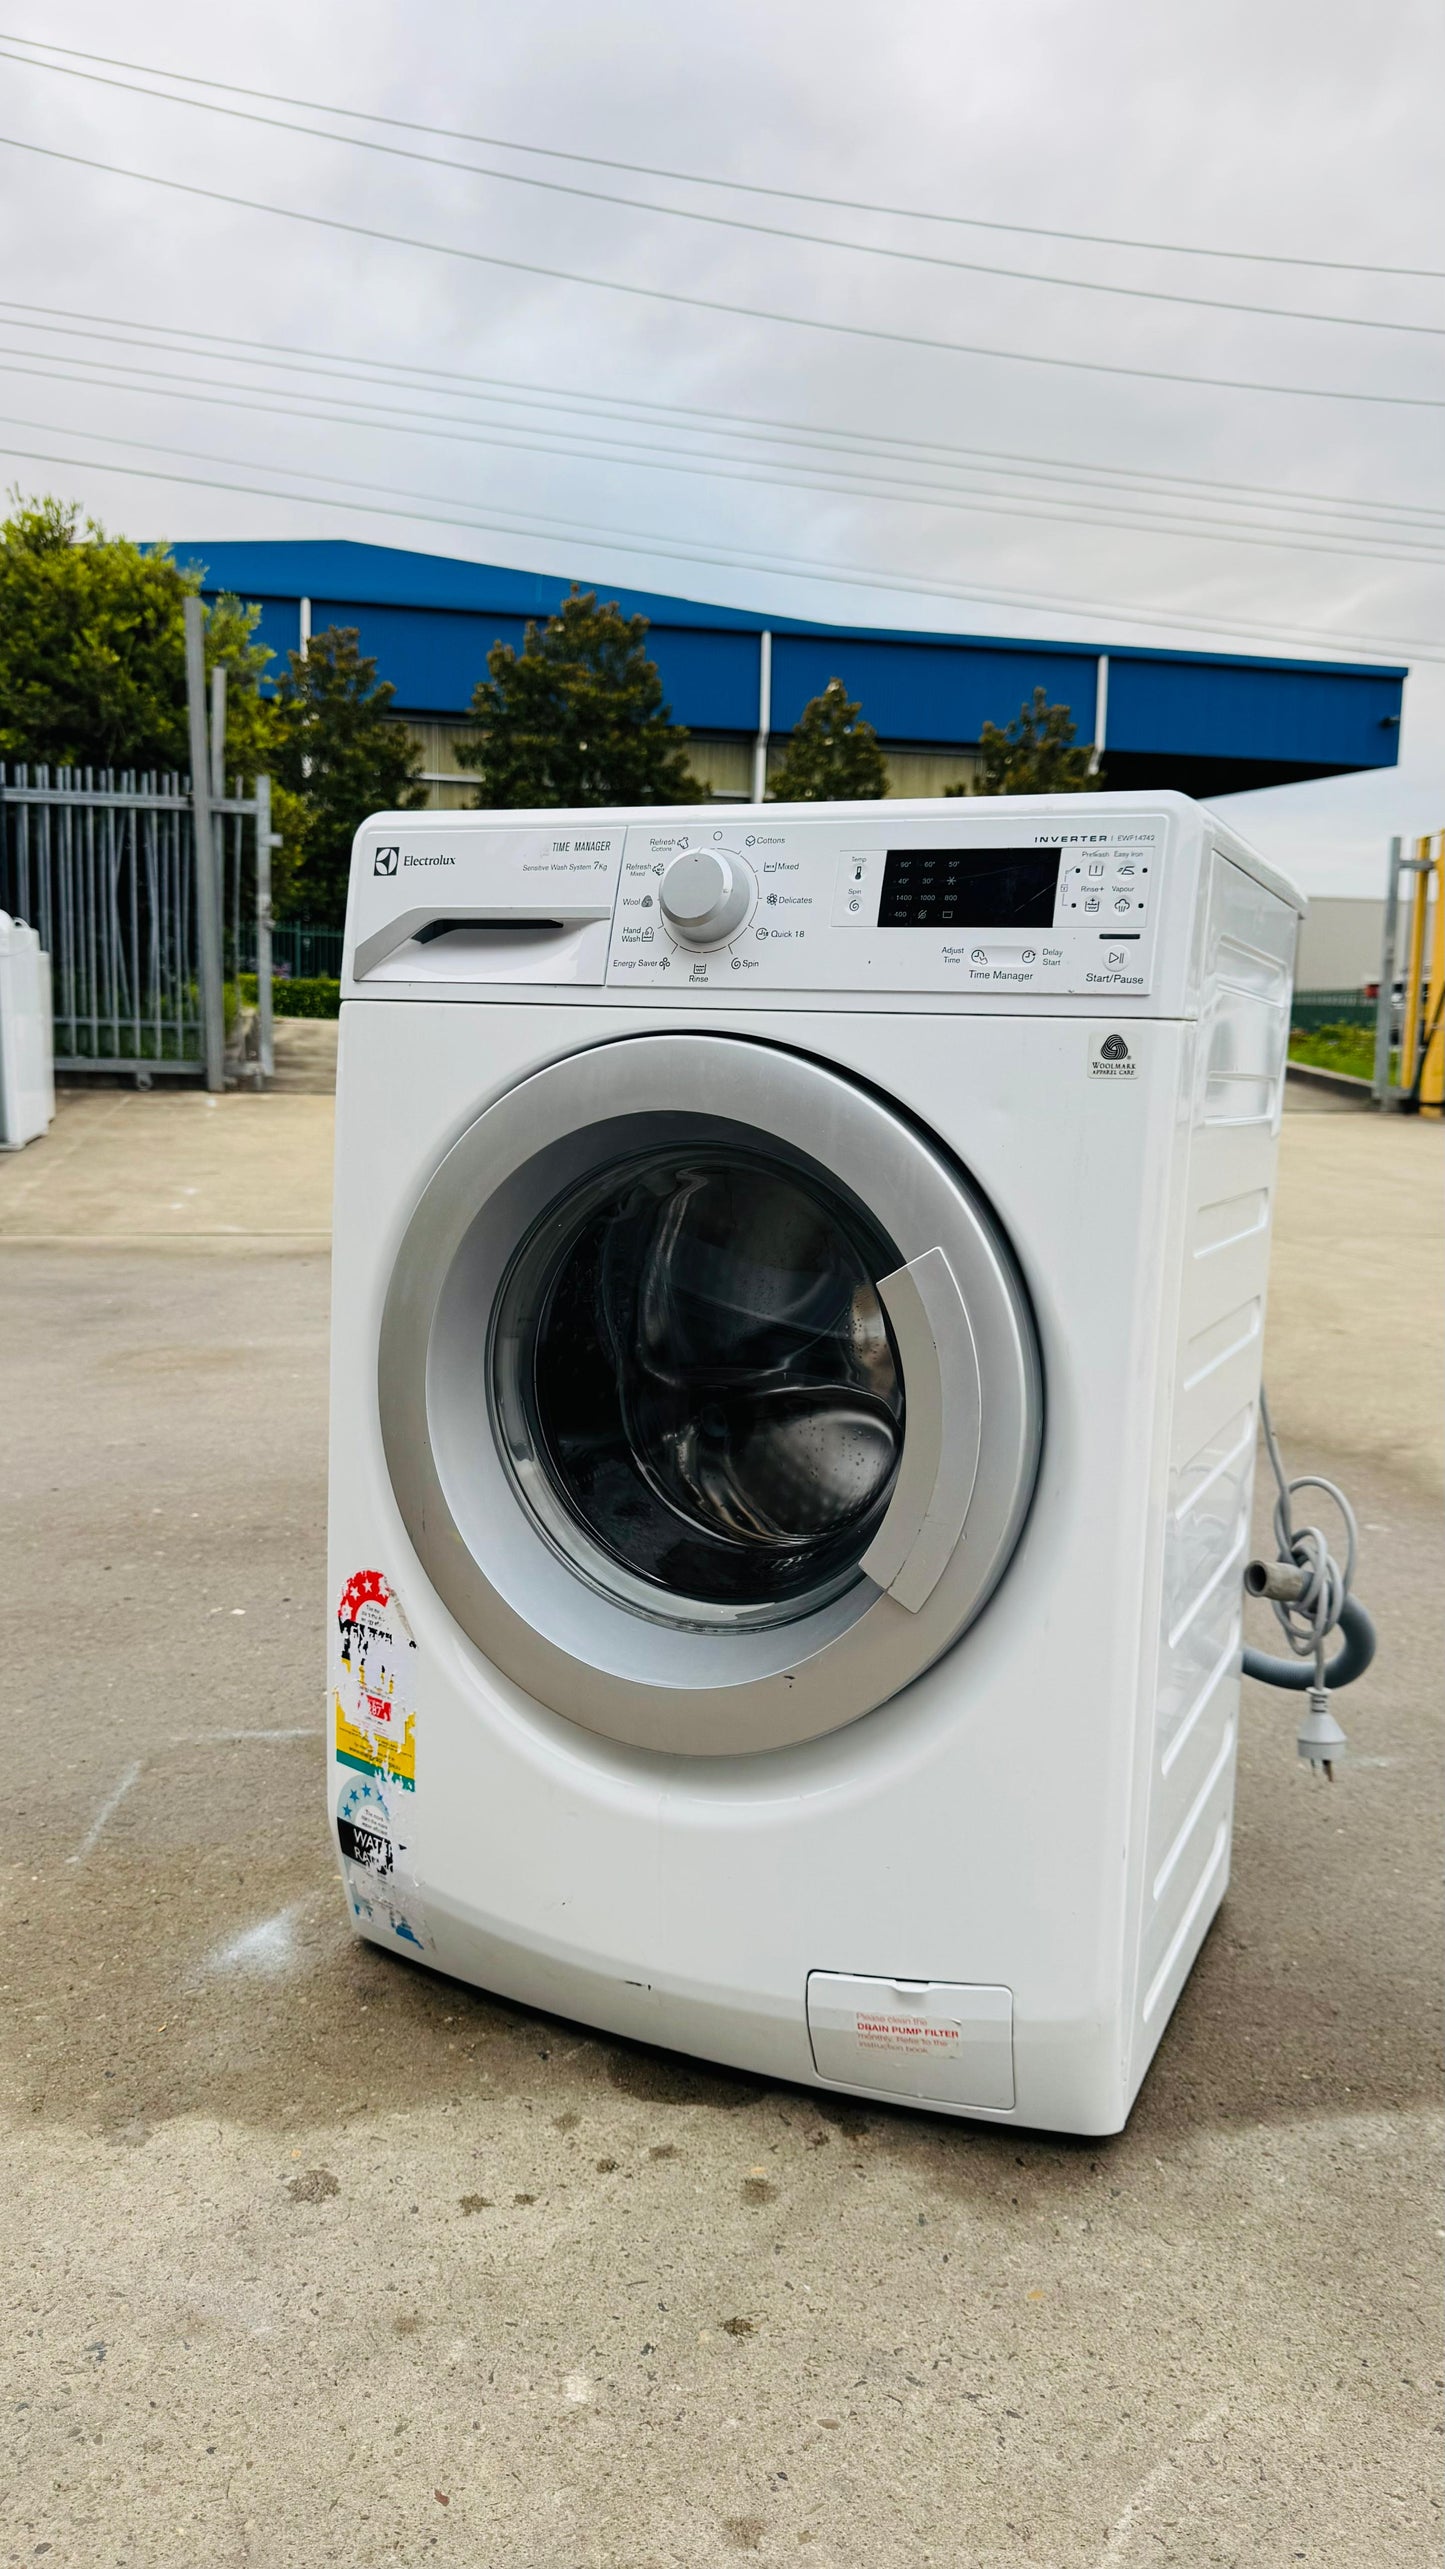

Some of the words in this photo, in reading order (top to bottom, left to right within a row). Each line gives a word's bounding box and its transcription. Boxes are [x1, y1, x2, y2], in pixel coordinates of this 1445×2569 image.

[650, 838, 676, 846] Refresh
[1034, 835, 1107, 843] INVERTER
[552, 842, 571, 853] TIME
[574, 841, 611, 852] MANAGER
[1113, 851, 1129, 859] Easy
[404, 854, 456, 867] Electrolux
[522, 863, 549, 872] Sensitive
[550, 863, 568, 871] Wash
[568, 863, 592, 872] System
[626, 863, 651, 871] Refresh
[848, 888, 862, 896] Spin
[622, 898, 641, 906] Wool
[778, 896, 813, 904] Delicates
[771, 930, 792, 938] Quick
[794, 930, 805, 938] 18
[621, 935, 641, 943] Wash
[941, 946, 964, 955] Adjust
[1042, 948, 1064, 958] Delay
[613, 960, 637, 968] Energy
[742, 959, 759, 968] Spin
[943, 956, 961, 964] Time
[1042, 958, 1061, 966] Start
[688, 975, 709, 983] Rinse
[969, 969, 991, 979] Time
[993, 970, 1033, 981] Manager
[1085, 972, 1144, 985] Start/Pause
[856, 2012, 886, 2022] Please
[913, 2018, 928, 2026] the
[857, 2023, 889, 2033] DRAIN
[892, 2026, 922, 2035] PUMP
[925, 2029, 959, 2039] FILTER
